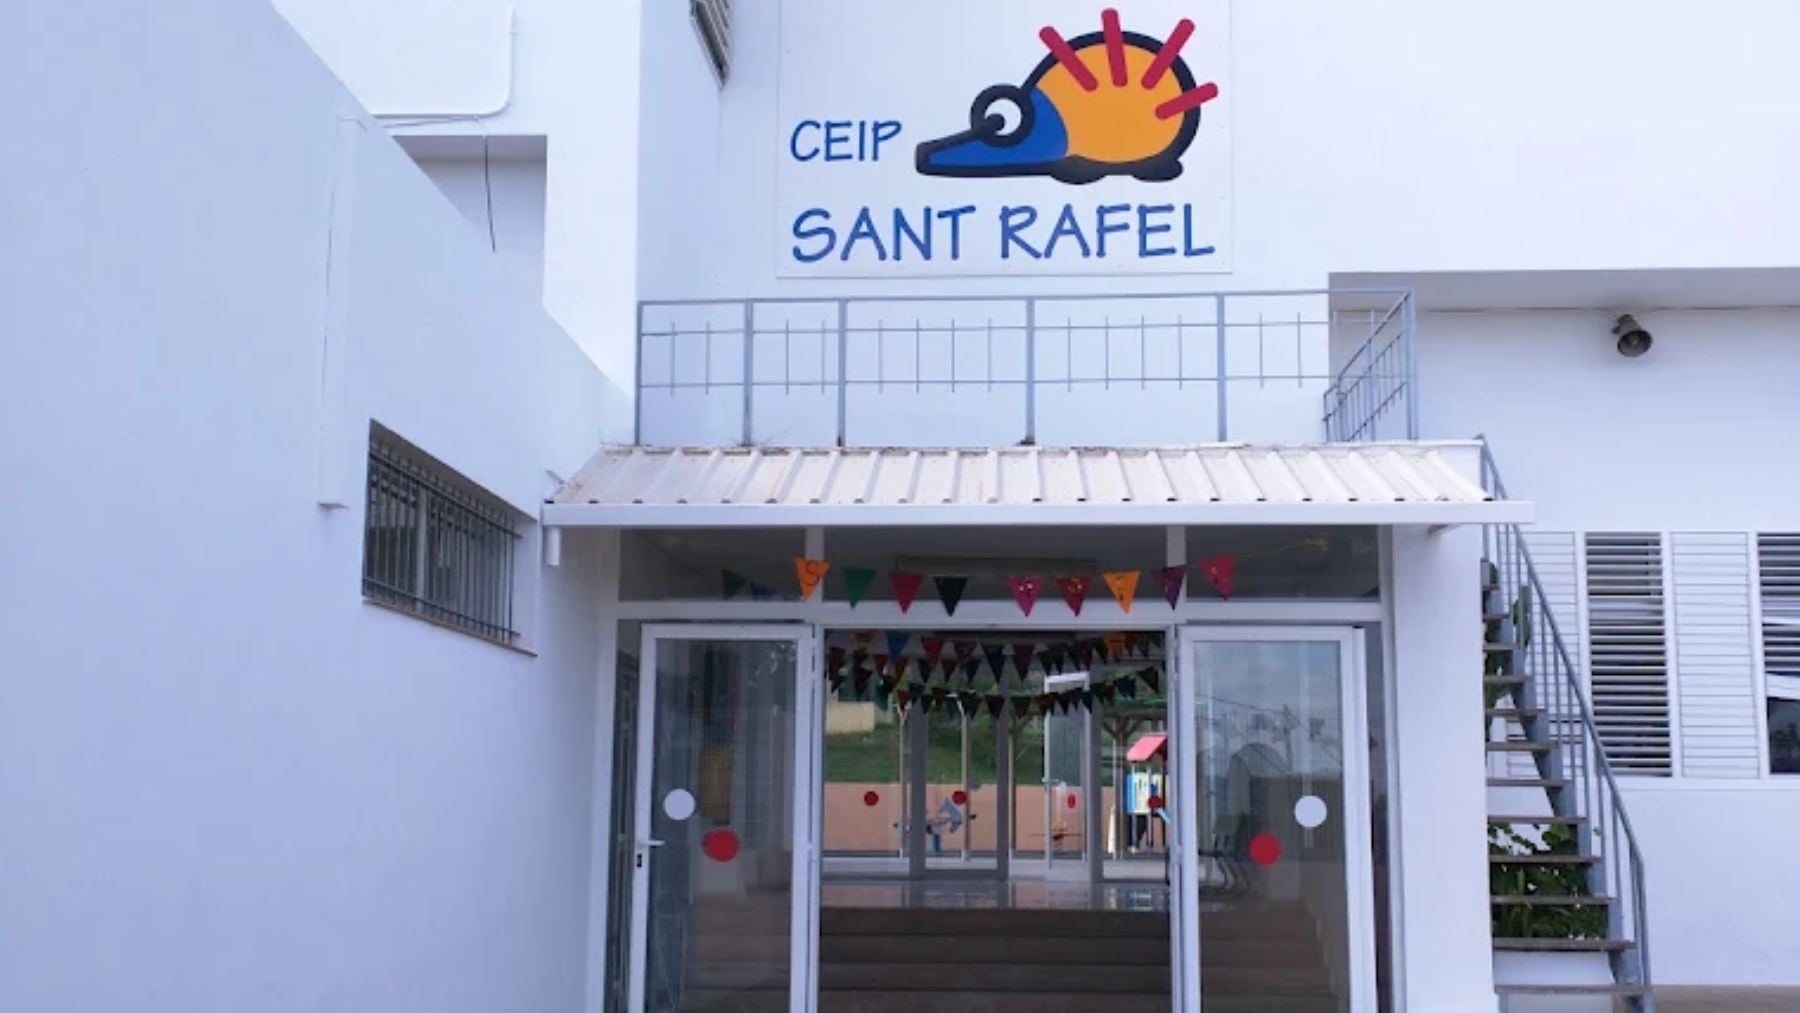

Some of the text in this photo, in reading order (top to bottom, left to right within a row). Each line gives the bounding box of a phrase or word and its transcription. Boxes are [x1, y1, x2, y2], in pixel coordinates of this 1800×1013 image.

[789, 119, 902, 162] CEIP
[792, 203, 1215, 263] SANT RAFEL
